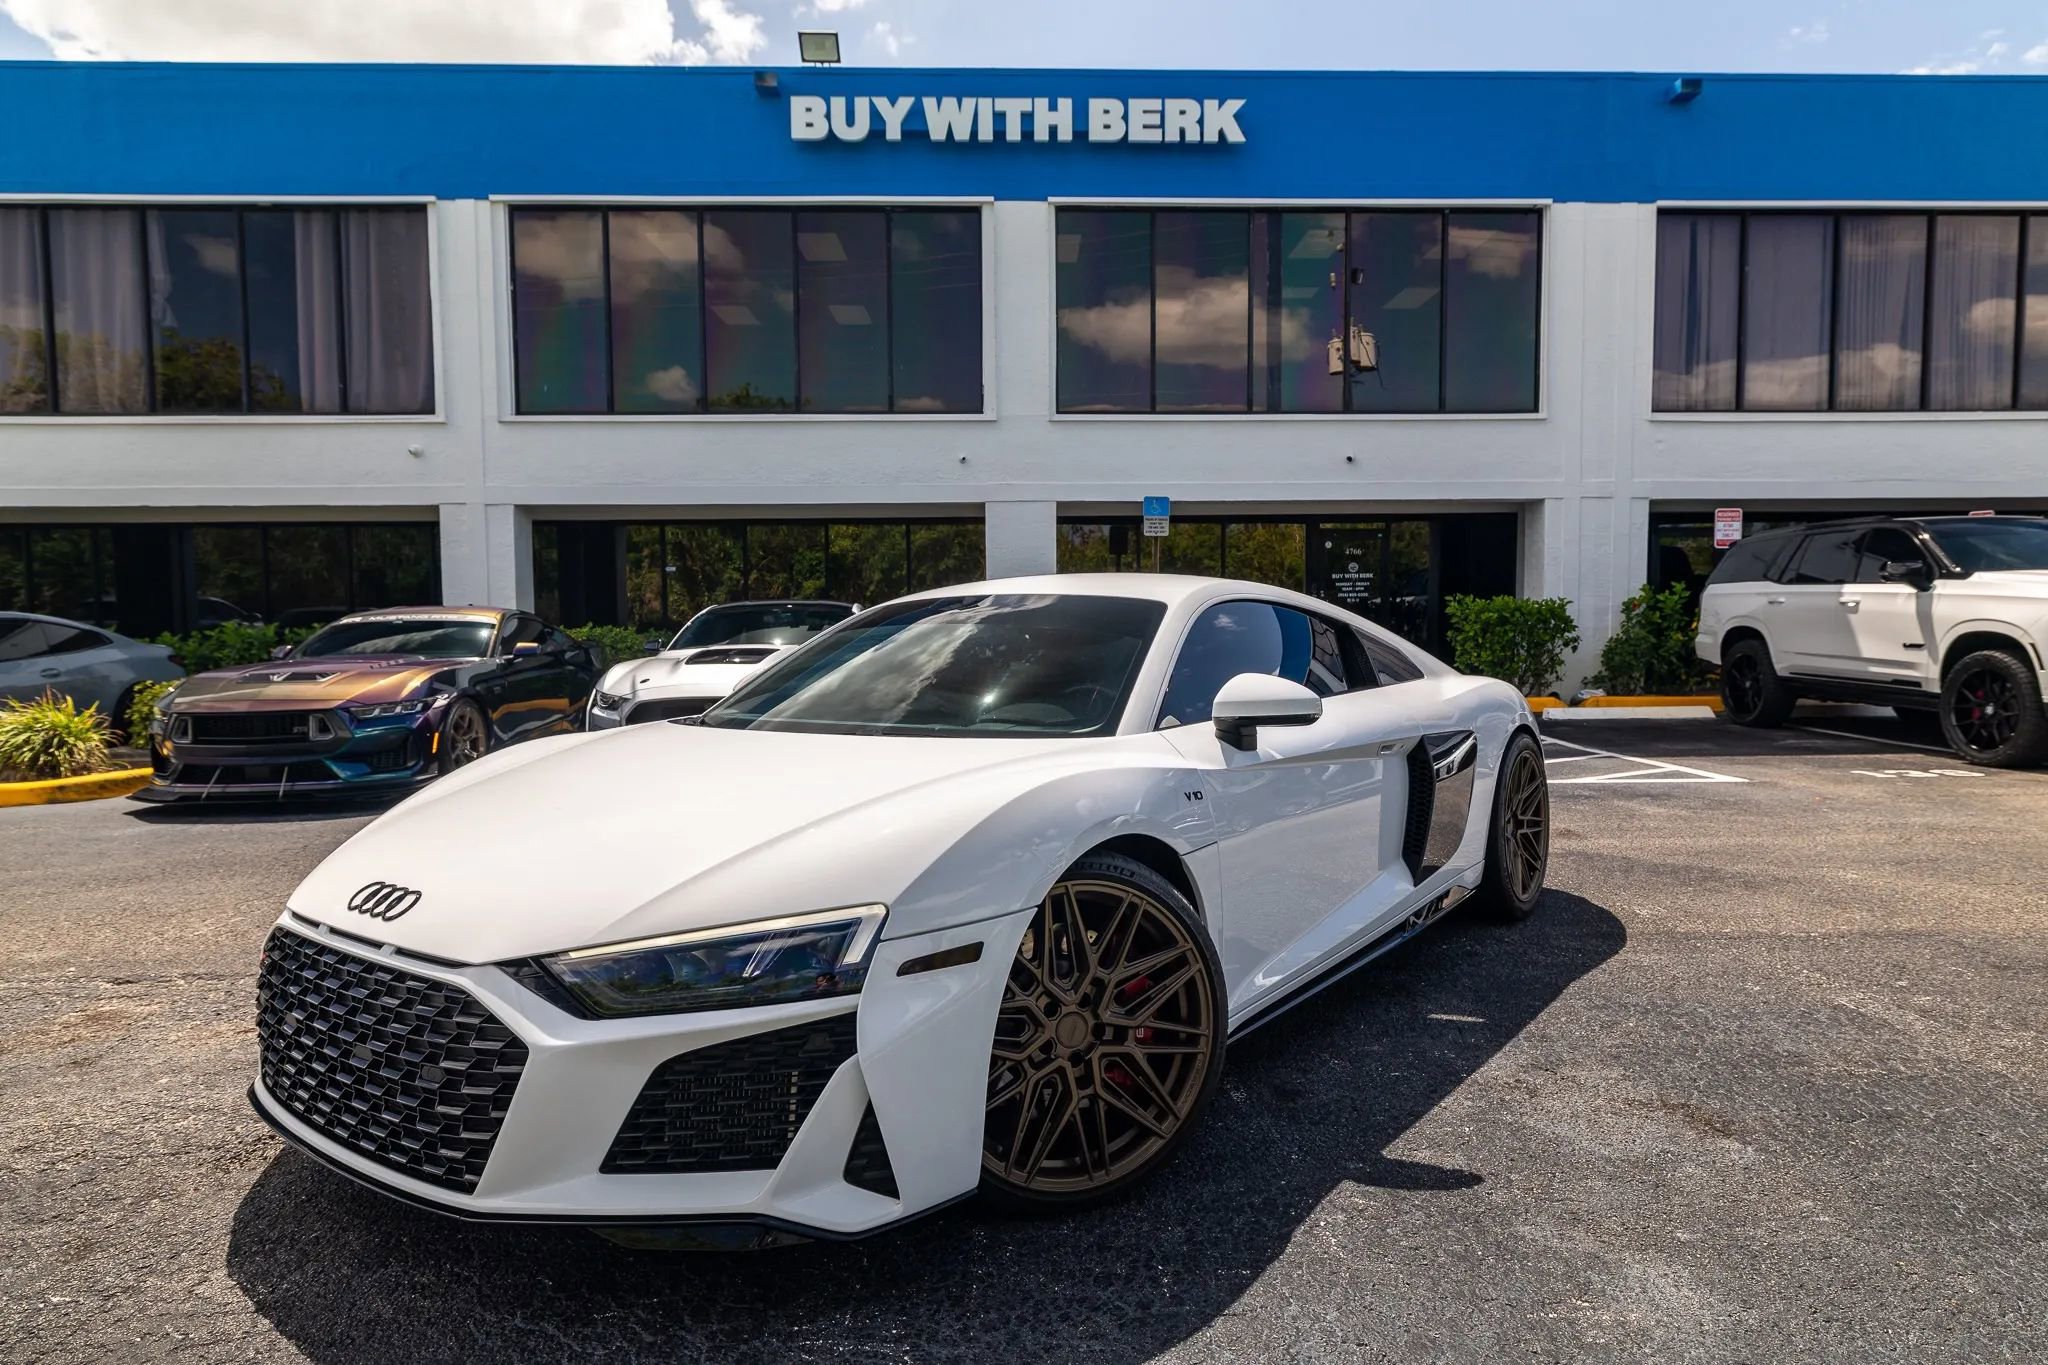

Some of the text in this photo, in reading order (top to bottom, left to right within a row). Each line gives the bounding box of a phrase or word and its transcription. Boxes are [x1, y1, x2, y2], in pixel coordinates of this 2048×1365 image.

[790, 96, 1247, 144] BUY WITH BERK
[1345, 547, 1362, 555] 4766
[1184, 790, 1204, 802] V10
[1073, 862, 1132, 877] ICHELIN
